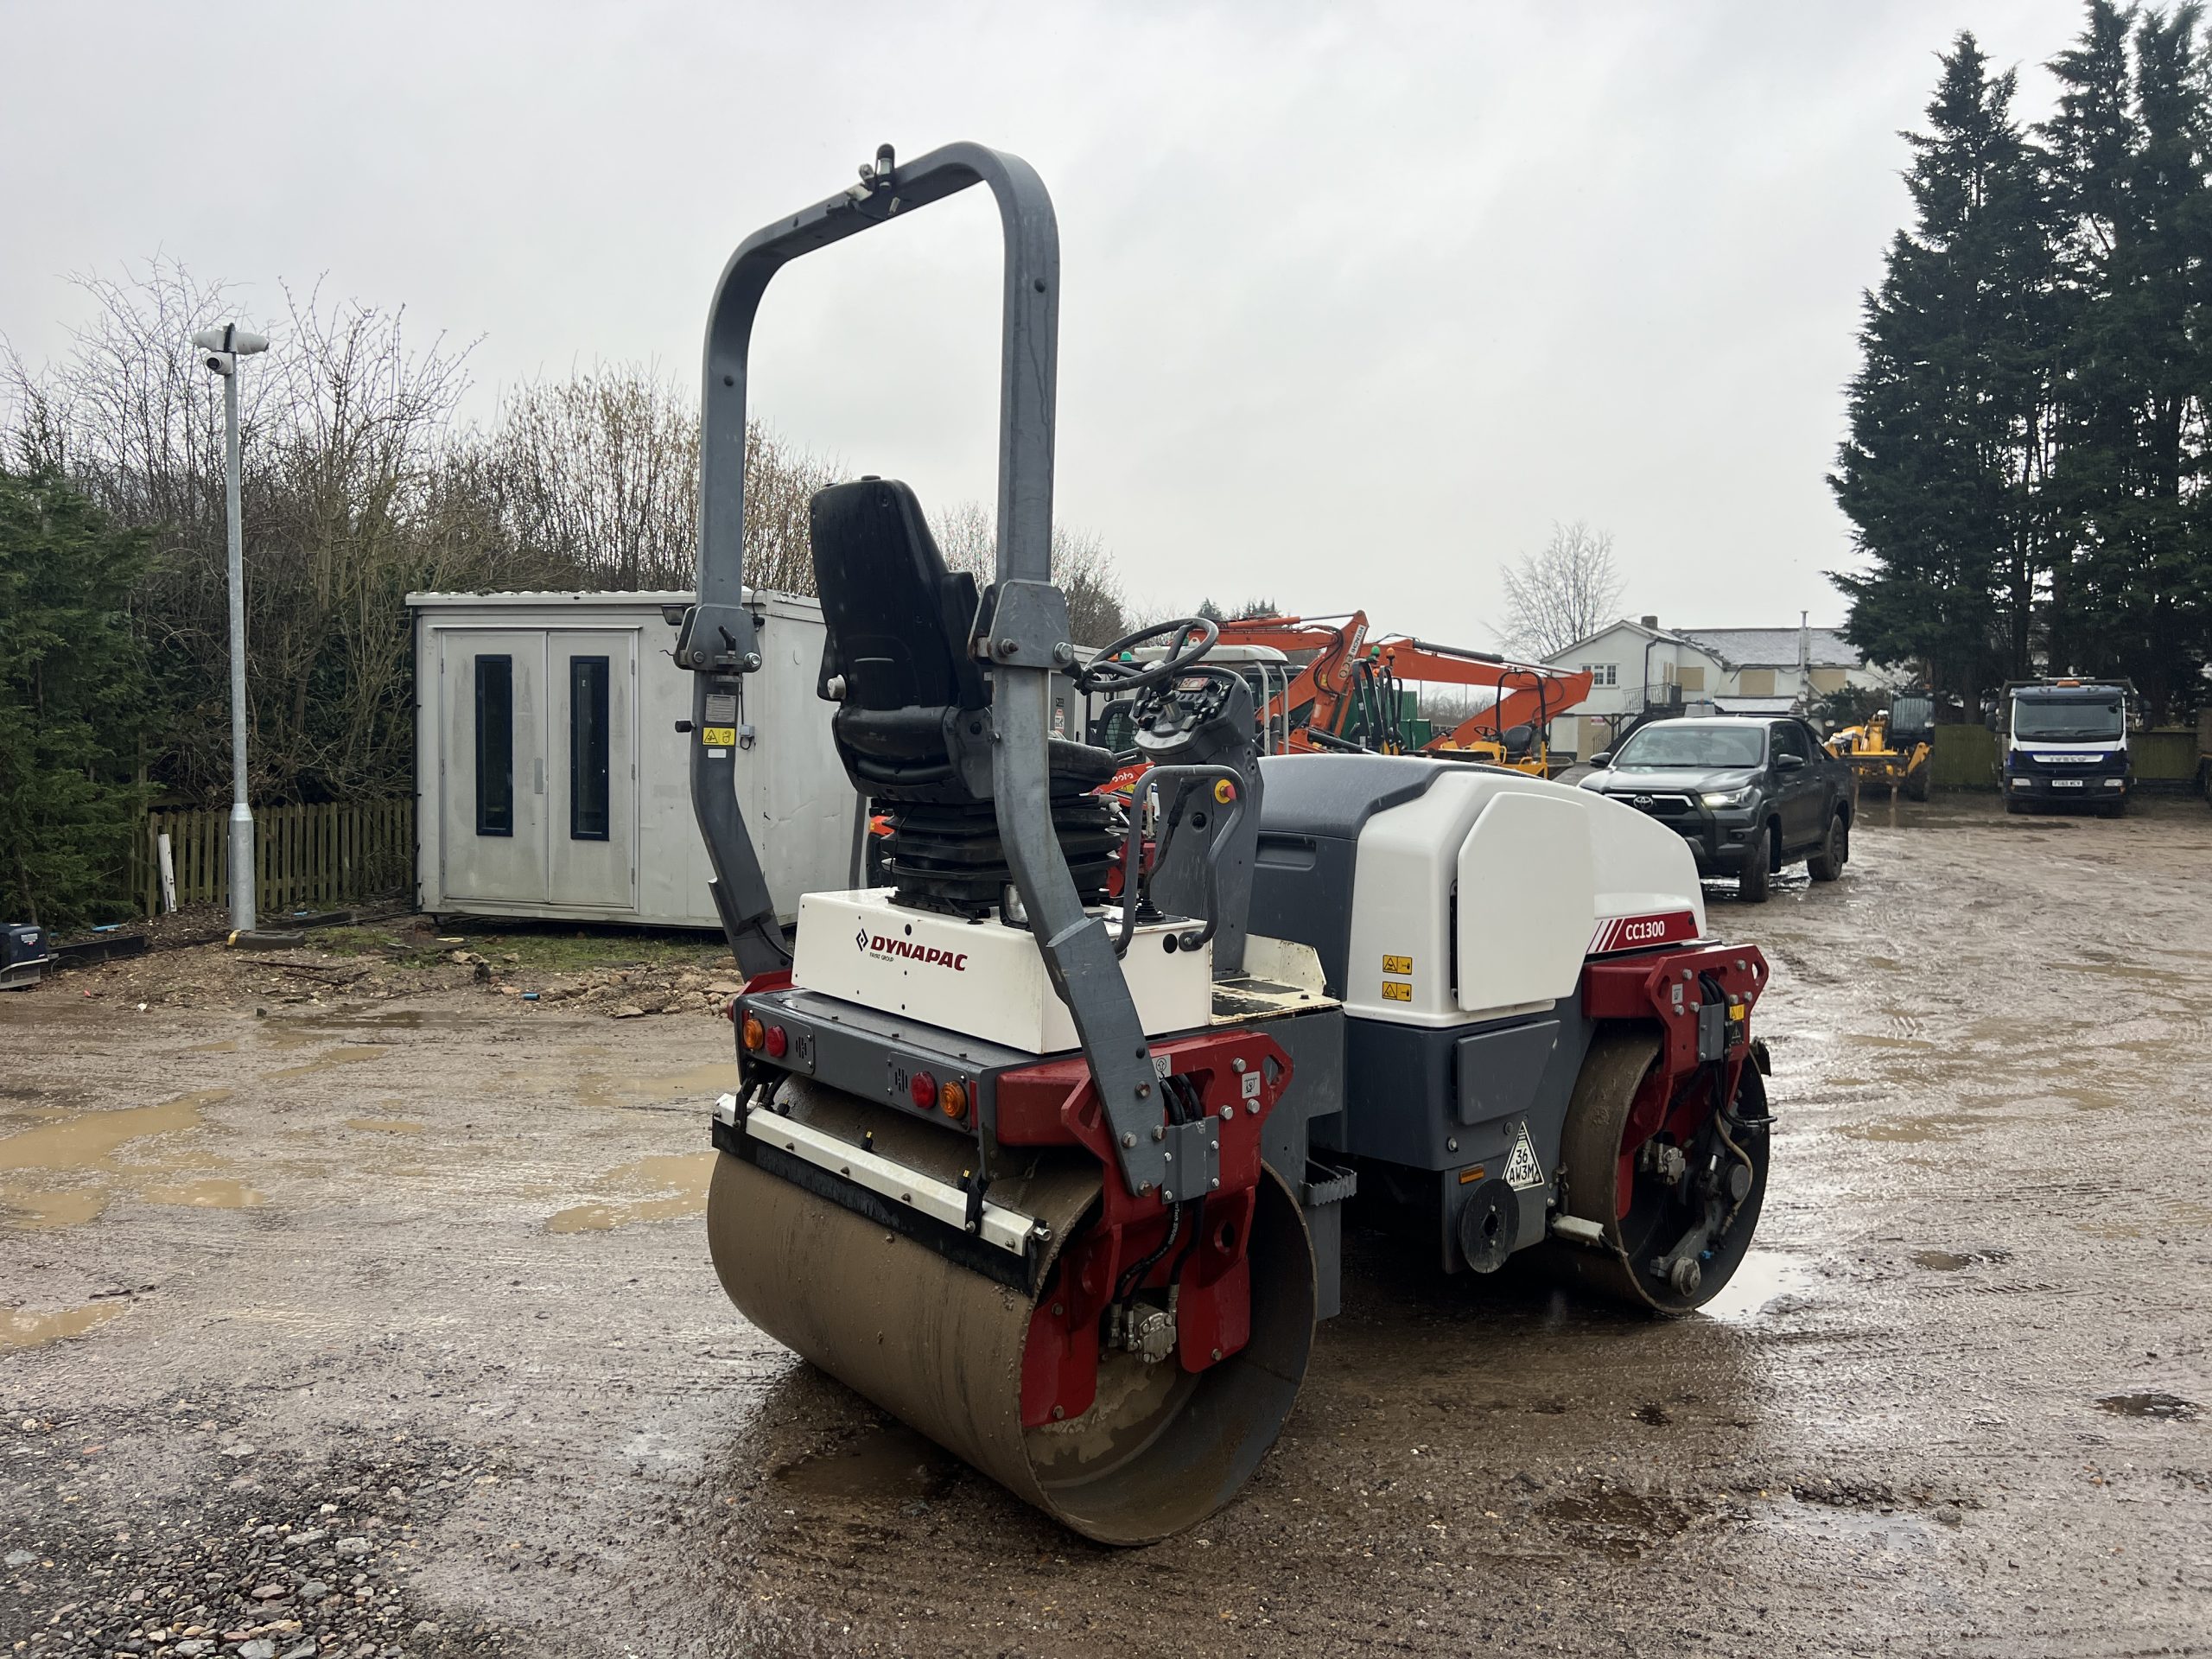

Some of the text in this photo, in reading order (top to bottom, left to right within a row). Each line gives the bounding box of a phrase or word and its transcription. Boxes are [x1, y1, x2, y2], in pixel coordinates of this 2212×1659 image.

[1351, 626, 1364, 653] HITACHI
[1625, 920, 1666, 941] CC1300
[870, 935, 968, 972] DYNAPAC
[880, 954, 894, 963] GROUP
[1516, 1147, 1529, 1165] 36
[1509, 1163, 1535, 1183] AW3M
